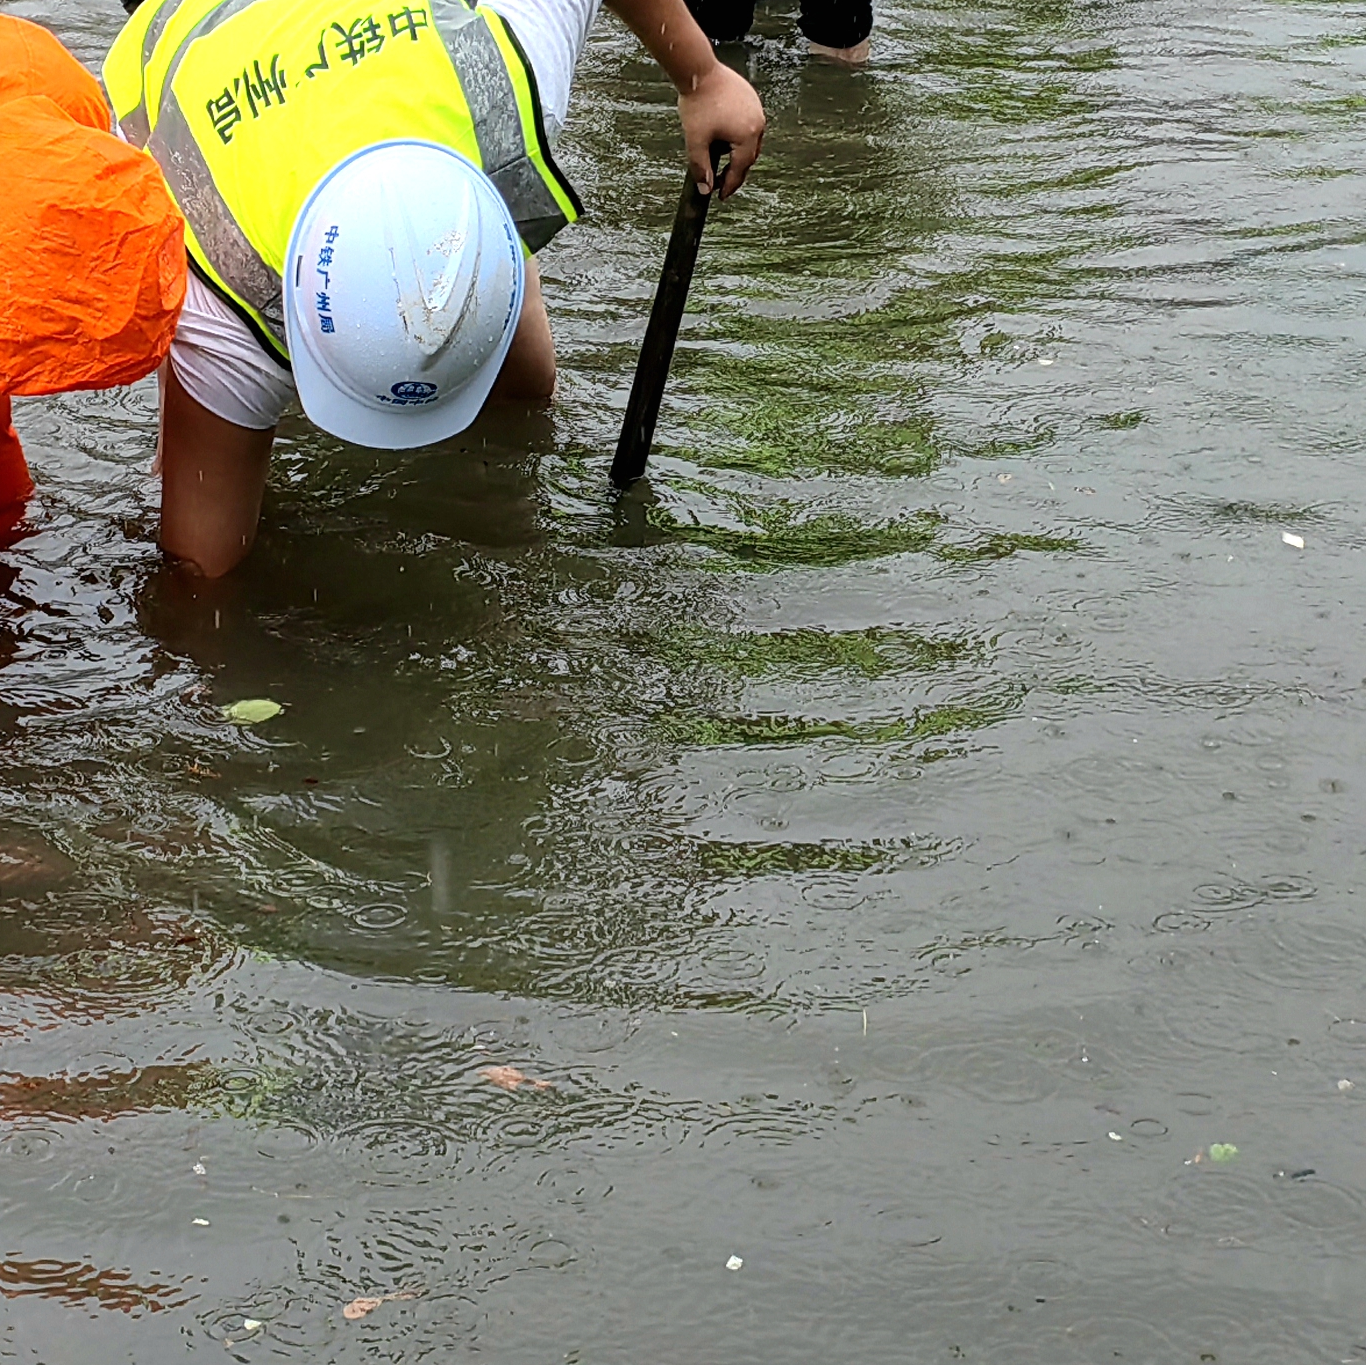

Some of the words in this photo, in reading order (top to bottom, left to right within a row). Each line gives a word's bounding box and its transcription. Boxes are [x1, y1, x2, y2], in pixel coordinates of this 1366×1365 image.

[205, 6, 429, 146] 中铁广州局
[316, 225, 340, 335] 中铁广州局
